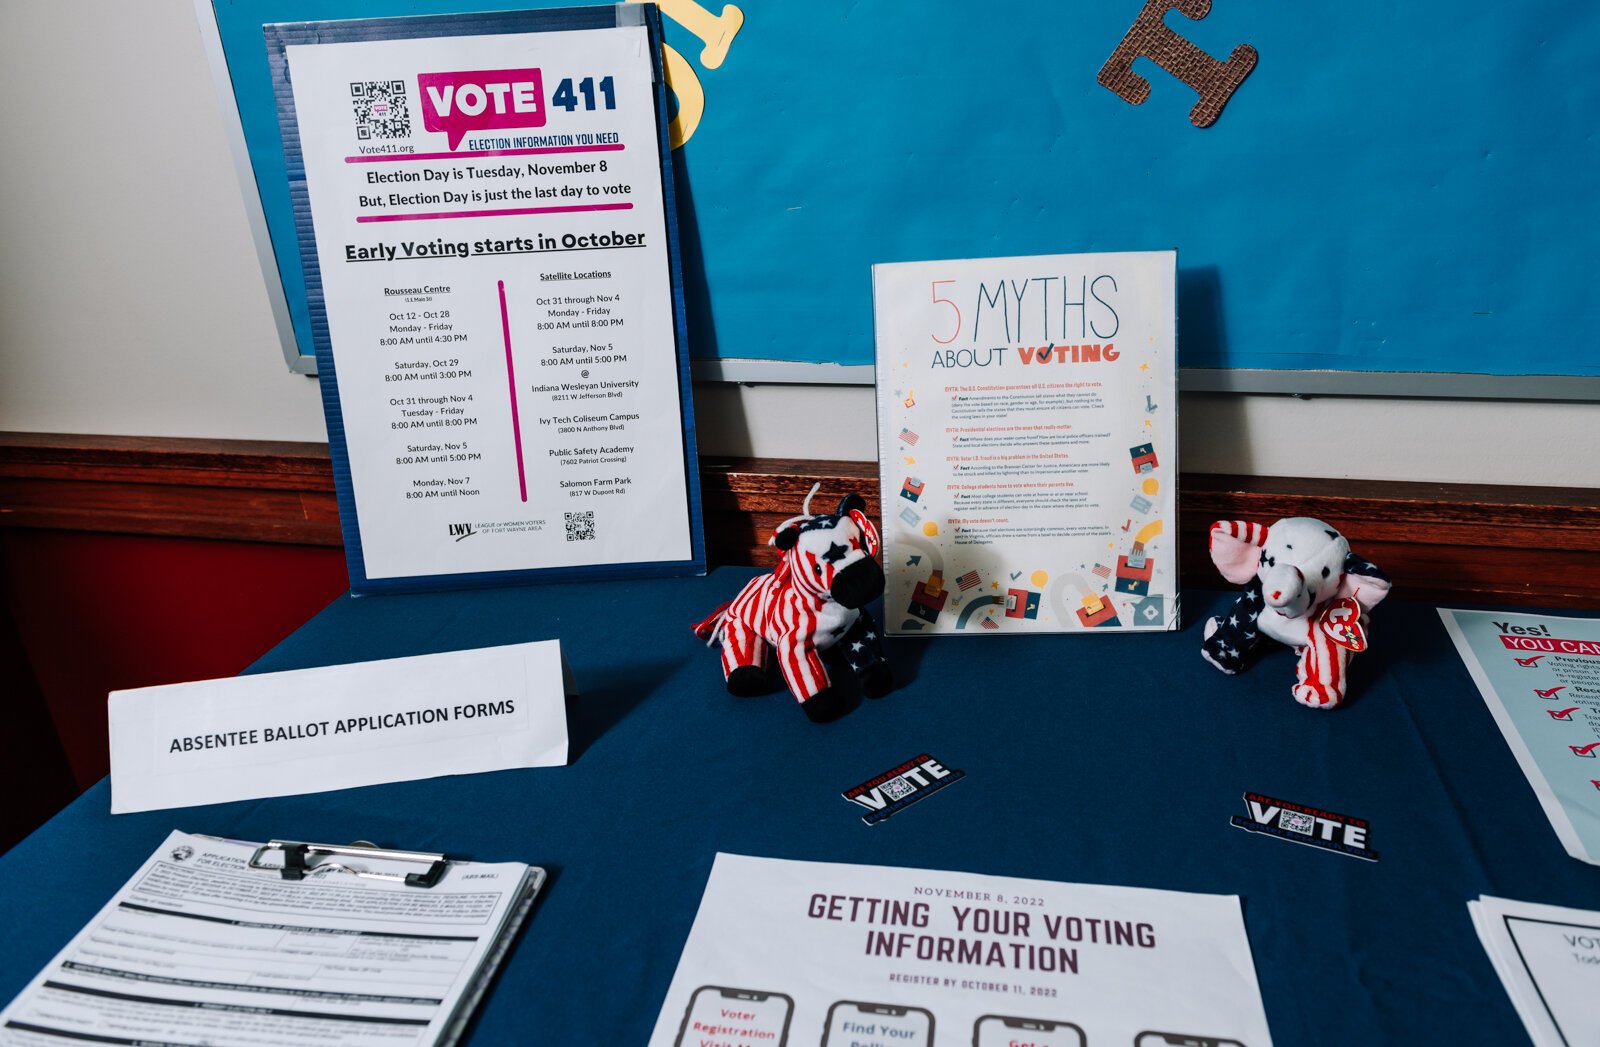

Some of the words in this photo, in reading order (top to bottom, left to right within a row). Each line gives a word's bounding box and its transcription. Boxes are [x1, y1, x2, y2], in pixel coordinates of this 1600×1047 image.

[426, 82, 536, 117] VOTE
[552, 76, 616, 112] 411
[359, 145, 414, 153] Vote411.org
[469, 137, 511, 150] ELECTION
[513, 135, 574, 149] INFORMATION
[576, 134, 594, 146] YOU
[596, 132, 619, 144] NEED
[367, 170, 420, 184] Election
[424, 169, 449, 182] Day
[453, 168, 463, 179] is
[466, 165, 524, 179] Tuesday,
[528, 162, 596, 176] November
[600, 160, 607, 172] 8
[359, 196, 386, 207] But,
[389, 193, 440, 205] Election
[444, 192, 468, 204] Day
[472, 190, 482, 201] is
[485, 190, 508, 203] just
[511, 188, 532, 199] the
[535, 187, 557, 198] last
[561, 185, 583, 198] day
[586, 185, 599, 195] to
[603, 184, 631, 194] vote
[346, 243, 396, 262] Early
[402, 238, 469, 257] Voting
[474, 234, 533, 252] starts
[538, 232, 557, 250] in
[561, 230, 645, 248] October
[540, 272, 572, 280] Satellite
[574, 270, 611, 279] Locations
[565, 296, 595, 304] through
[932, 280, 961, 343] 5
[974, 275, 1119, 343] MYTHS
[932, 348, 1008, 368] ABOUT
[1018, 344, 1120, 364] VOTING
[600, 380, 639, 388] University
[1492, 622, 1551, 636] Yes!
[1506, 637, 1554, 651] YOU
[170, 730, 258, 753] ABSENTEE
[264, 722, 329, 742] BALLOT
[335, 708, 448, 734] APPLICATION
[454, 700, 514, 720] FORMS
[847, 786, 865, 798] ARE
[866, 775, 886, 789] YOU
[887, 761, 915, 778] READY
[916, 754, 929, 763] TO
[1248, 794, 1270, 805] ARE
[1275, 799, 1300, 811] YOU
[1304, 805, 1345, 821] READY
[1349, 817, 1366, 827] TO
[914, 887, 990, 901] NOVEMBER
[997, 894, 1007, 904] 8,
[1014, 896, 1044, 906] 2022
[808, 894, 930, 928] GETTING
[952, 906, 1030, 937] YOUR
[1044, 914, 1156, 948] VOTING
[866, 931, 1078, 974] INFORMATION
[890, 974, 939, 985] REGISTER
[944, 978, 956, 987] BY
[962, 980, 1008, 992] OCTOBER
[1013, 985, 1025, 994] 11,
[1030, 987, 1057, 997] 2022
[722, 1010, 755, 1020] Voter
[694, 1022, 775, 1039] Registration
[843, 1022, 875, 1035] Find
[880, 1026, 915, 1039] Your
